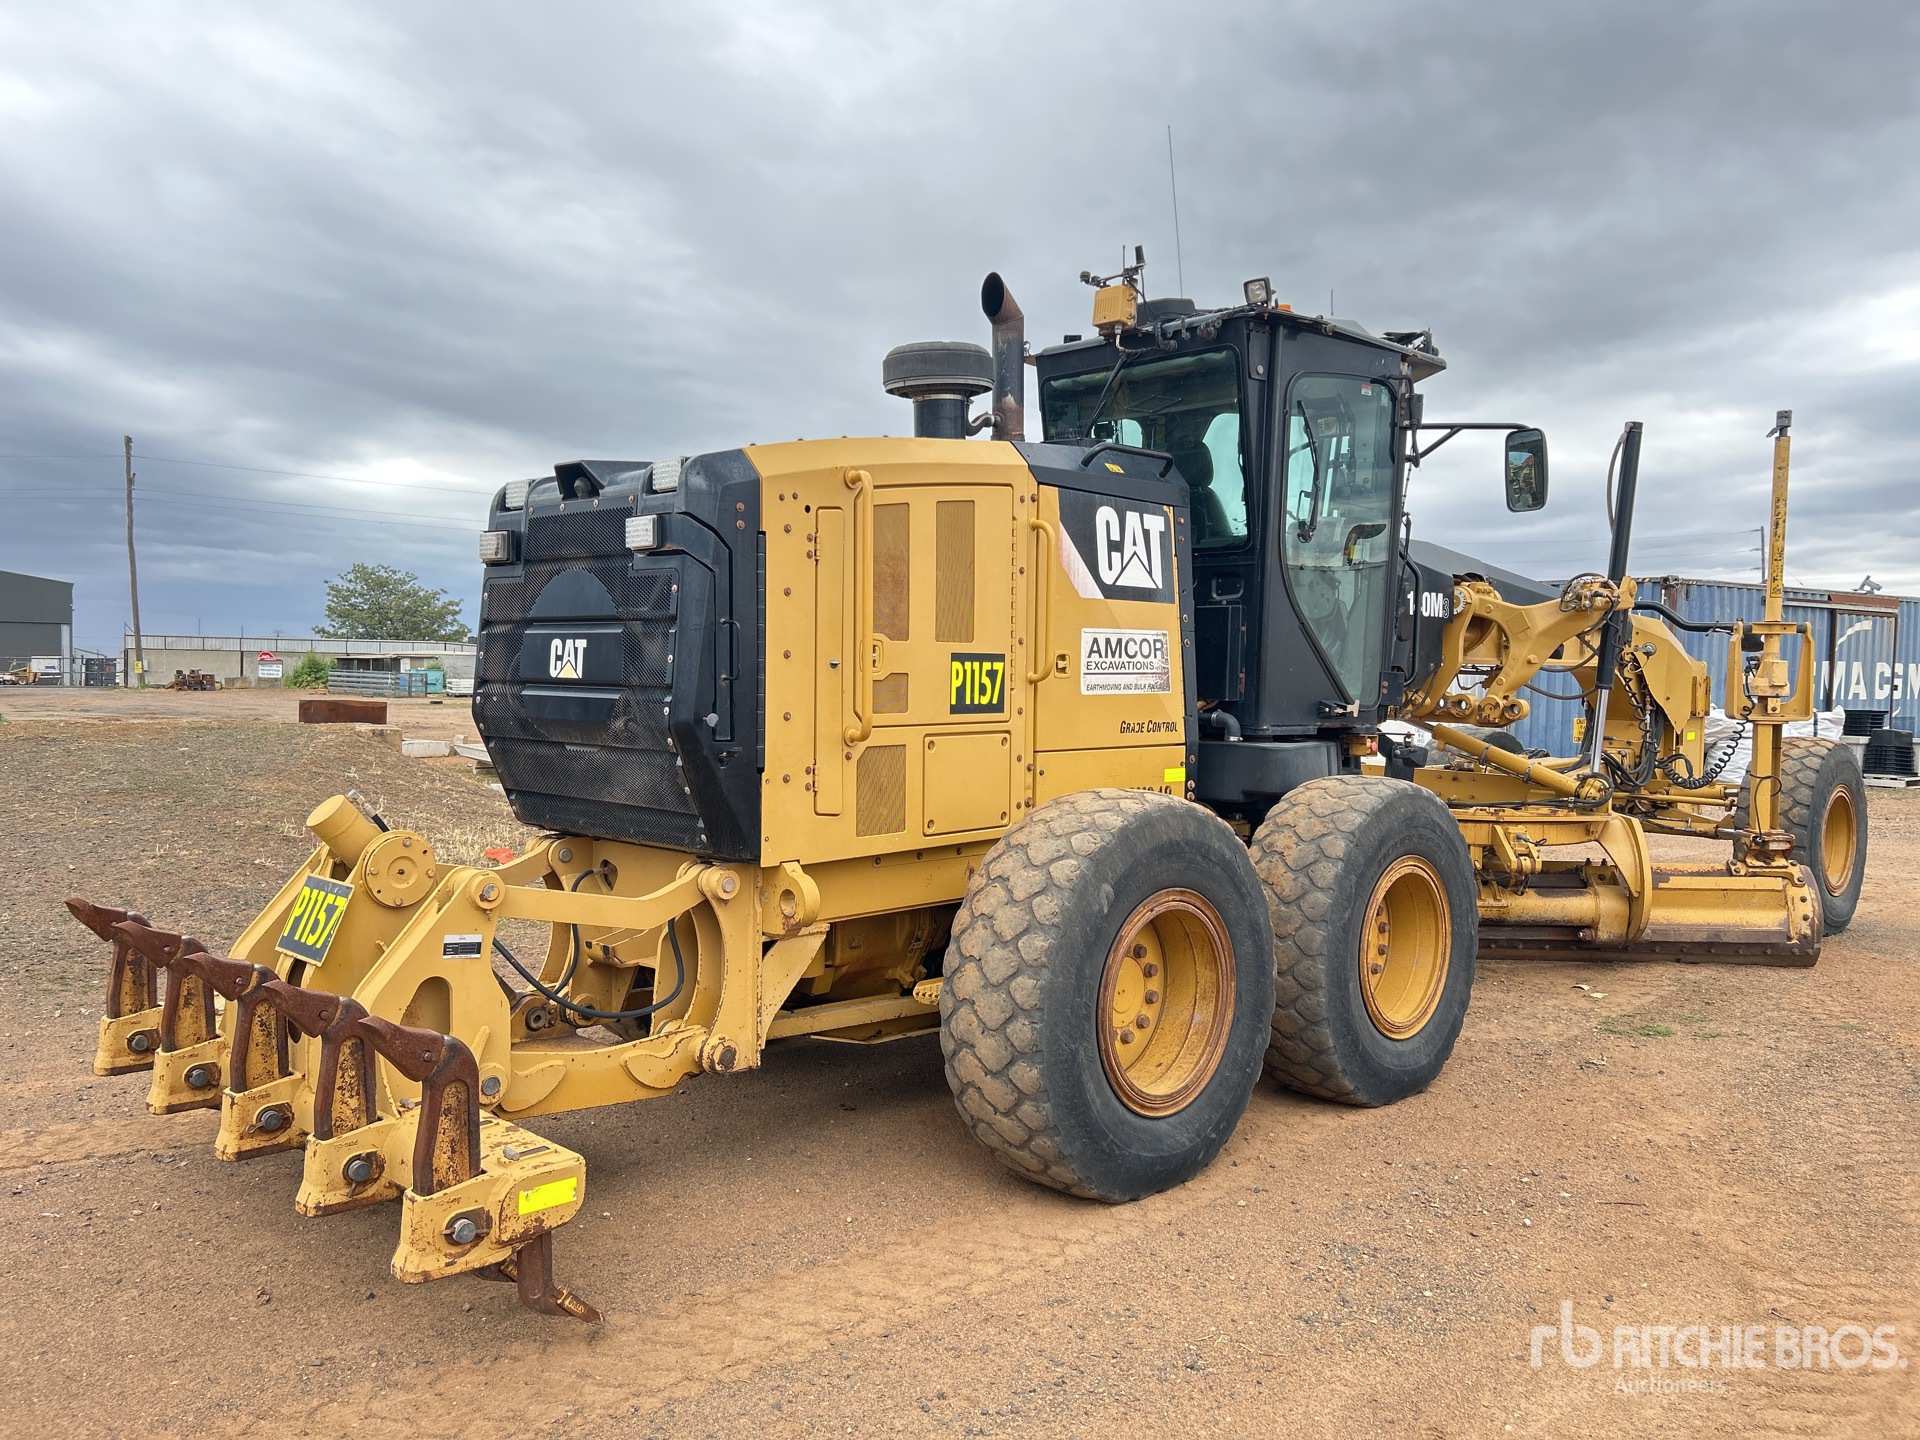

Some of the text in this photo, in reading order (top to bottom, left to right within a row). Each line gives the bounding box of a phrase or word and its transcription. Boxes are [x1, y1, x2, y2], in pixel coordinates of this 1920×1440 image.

[1095, 505, 1165, 590] CAT
[1407, 590, 1450, 619] 10M3
[549, 638, 587, 679] CAT
[1086, 637, 1165, 660] AMCOR
[1086, 660, 1155, 671] EXCAVATIONS
[950, 661, 1005, 706] P1157
[1086, 683, 1122, 692] EARTHMOVING
[1122, 683, 1133, 691] AND
[1133, 683, 1147, 691] BULK
[283, 886, 348, 950] P1157
